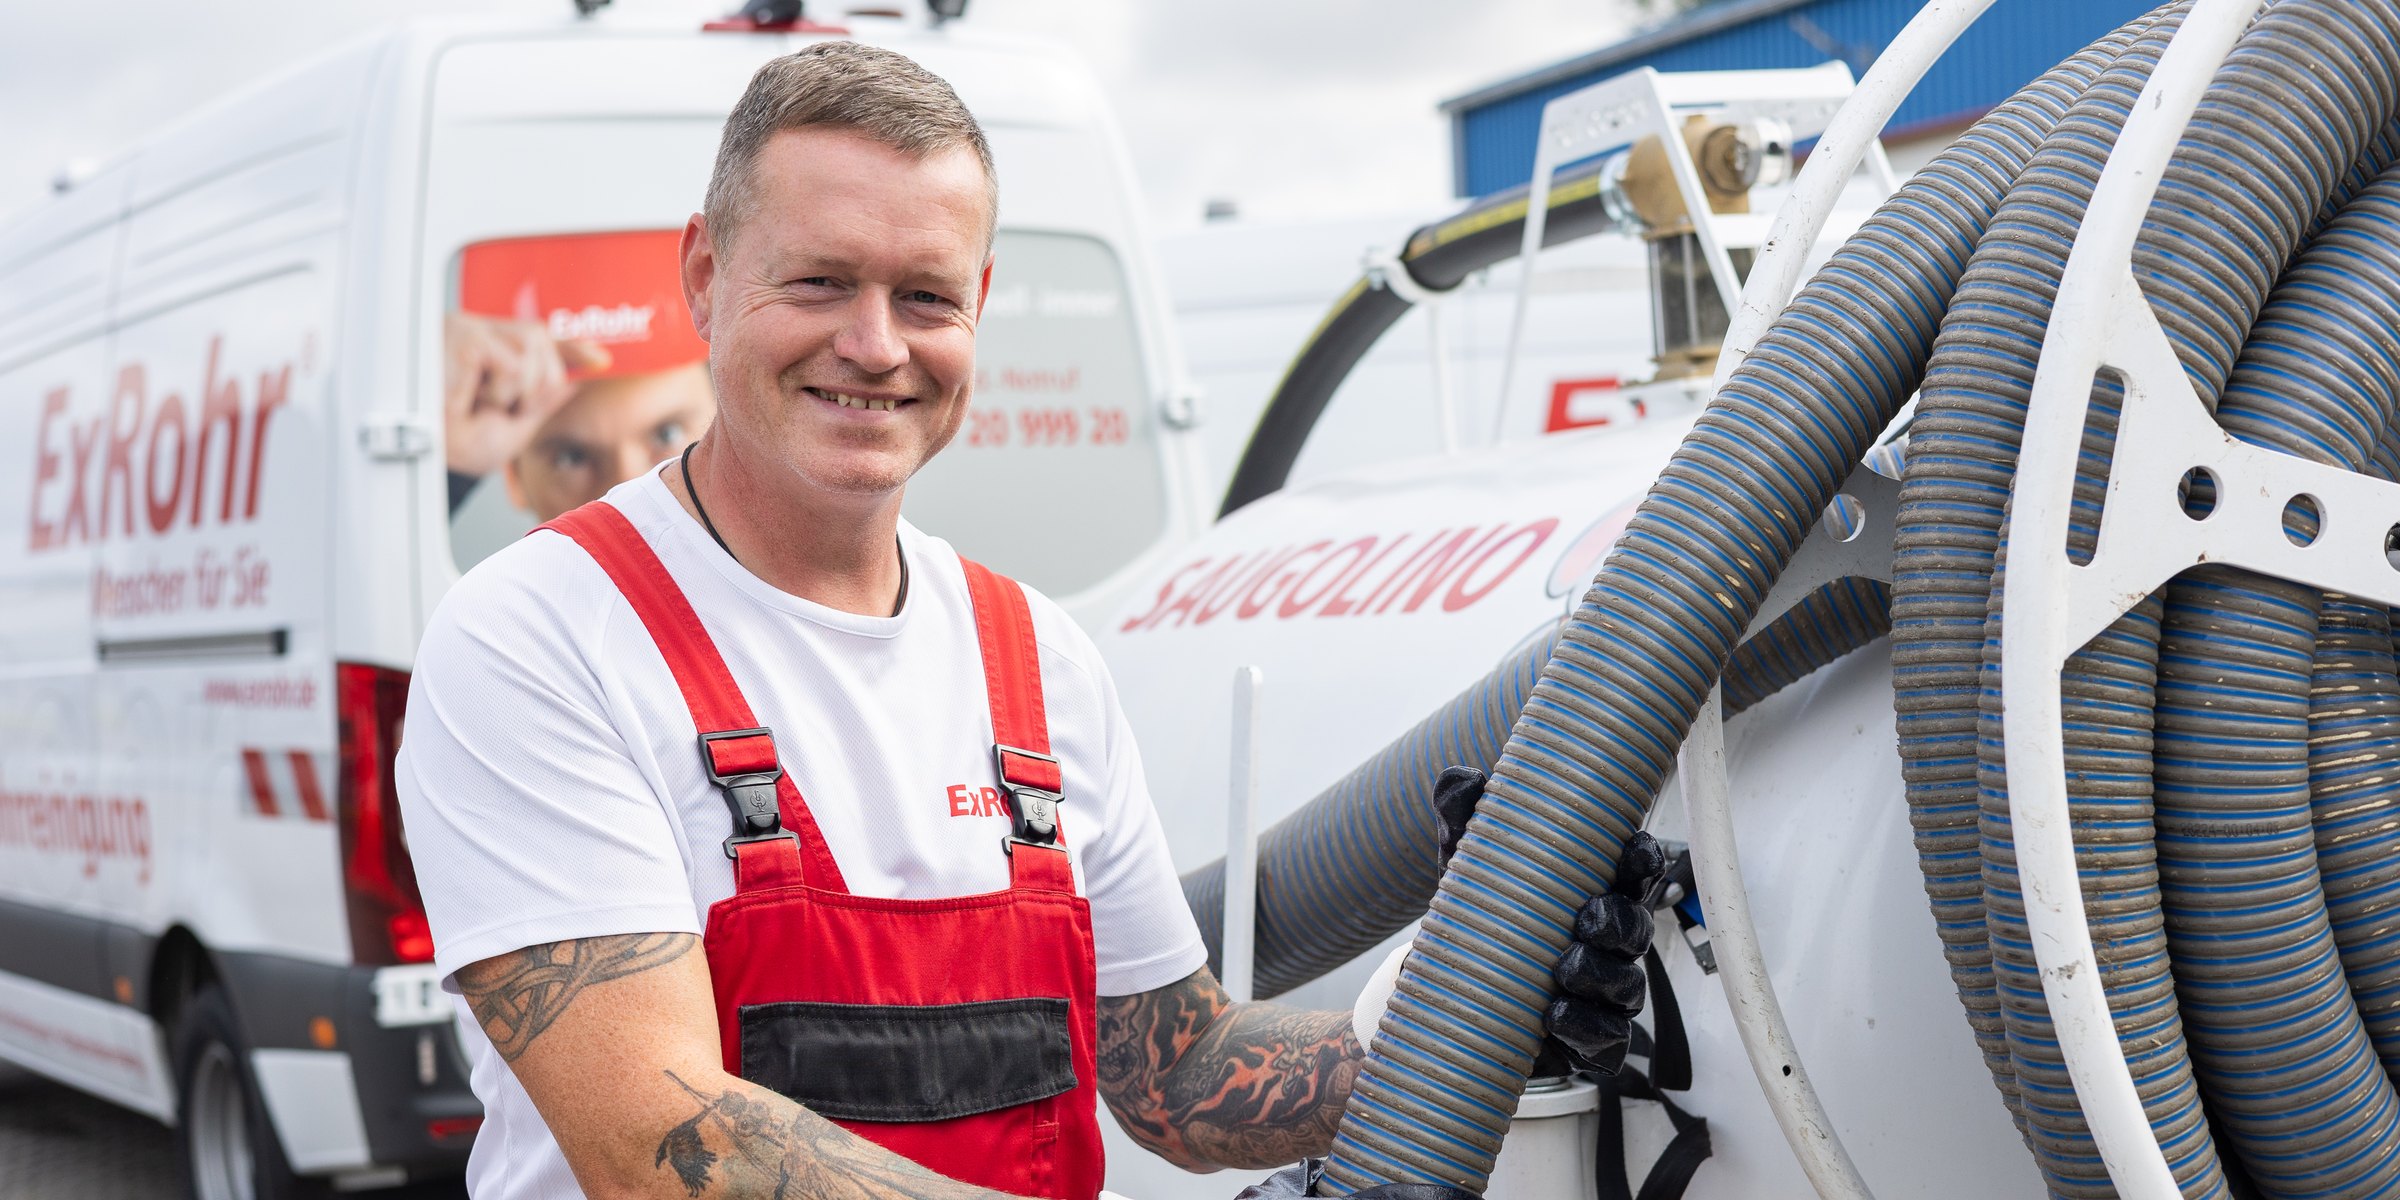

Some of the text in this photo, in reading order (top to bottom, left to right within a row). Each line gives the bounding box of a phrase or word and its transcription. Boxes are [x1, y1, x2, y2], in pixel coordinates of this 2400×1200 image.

[28, 334, 293, 554] ExRohr
[1017, 407, 1081, 446] 999
[1090, 407, 1130, 446] 20
[1119, 517, 1560, 634] SAUGOLINO
